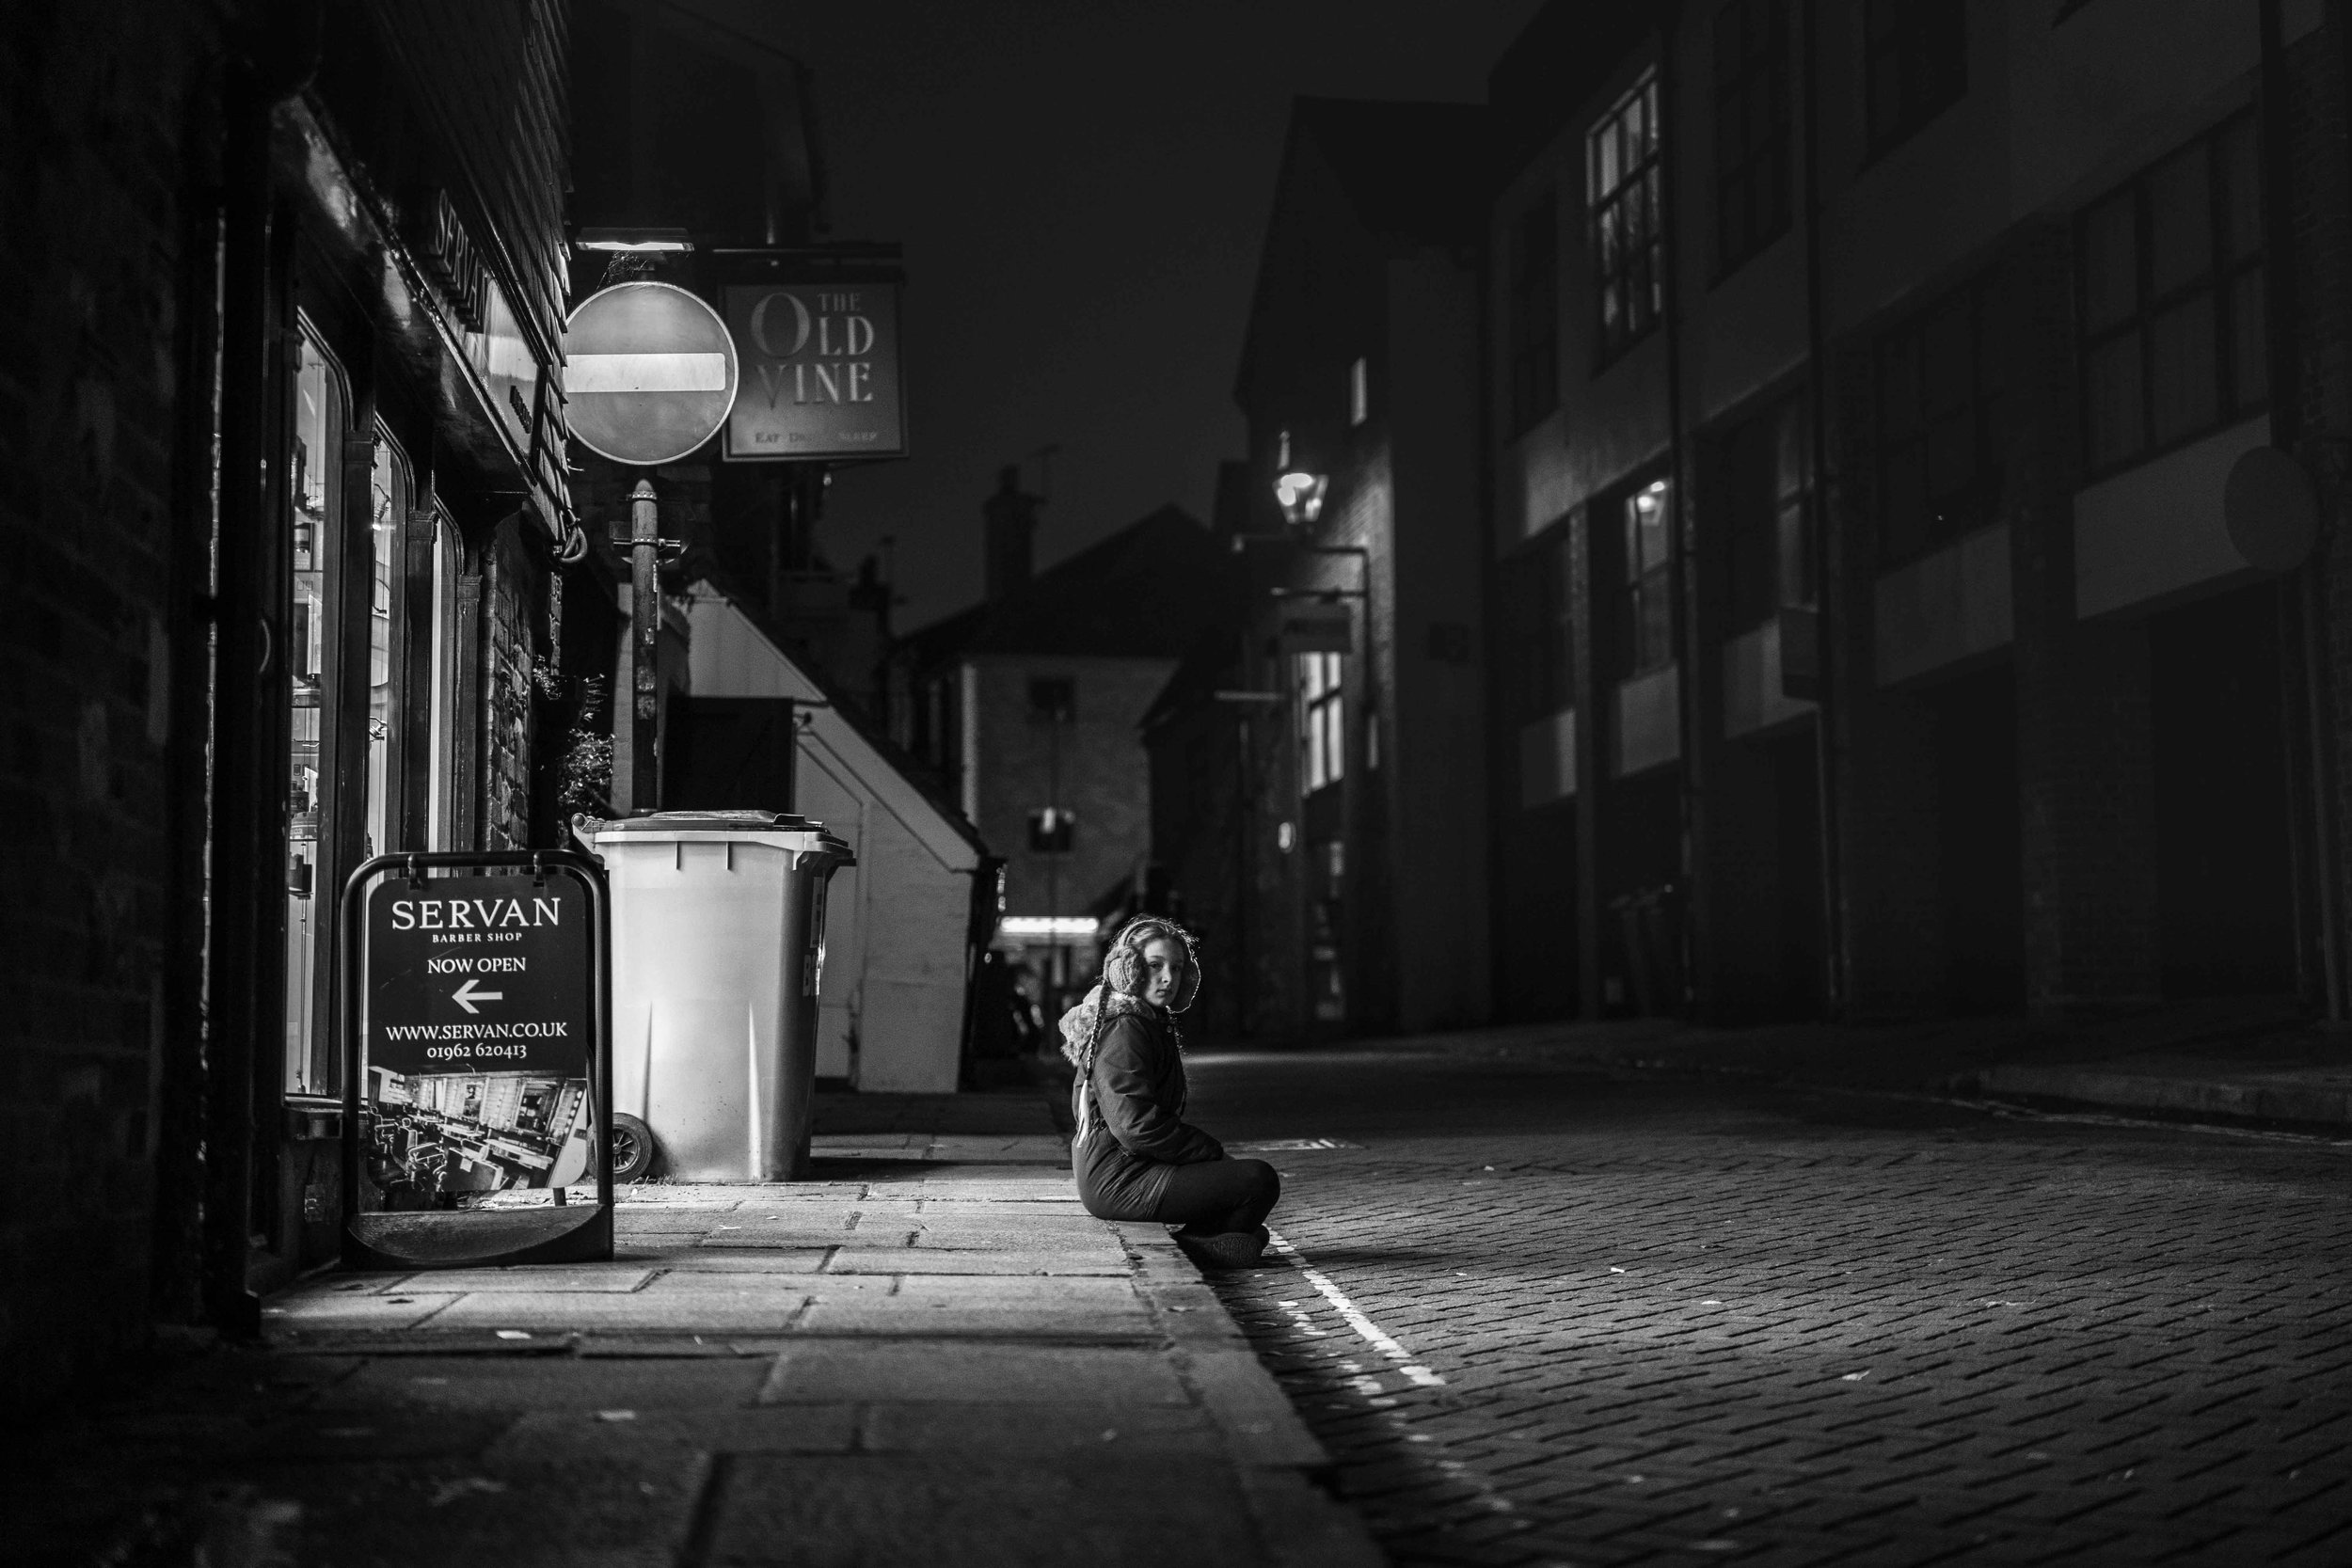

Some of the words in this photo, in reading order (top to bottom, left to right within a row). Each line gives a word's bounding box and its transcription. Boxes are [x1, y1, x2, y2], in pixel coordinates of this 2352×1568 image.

[817, 293, 861, 312] THE
[751, 293, 875, 356] OLD
[756, 362, 874, 411] VINE
[391, 897, 561, 930] SERVAN
[432, 934, 482, 943] BARBER
[487, 932, 523, 942] SHOP
[427, 959, 473, 974] NOW
[478, 958, 527, 973] OPEN
[386, 1022, 568, 1041] WWW.SERVAN.CO.UK
[426, 1044, 471, 1060] 01962
[475, 1042, 528, 1059] 620413
